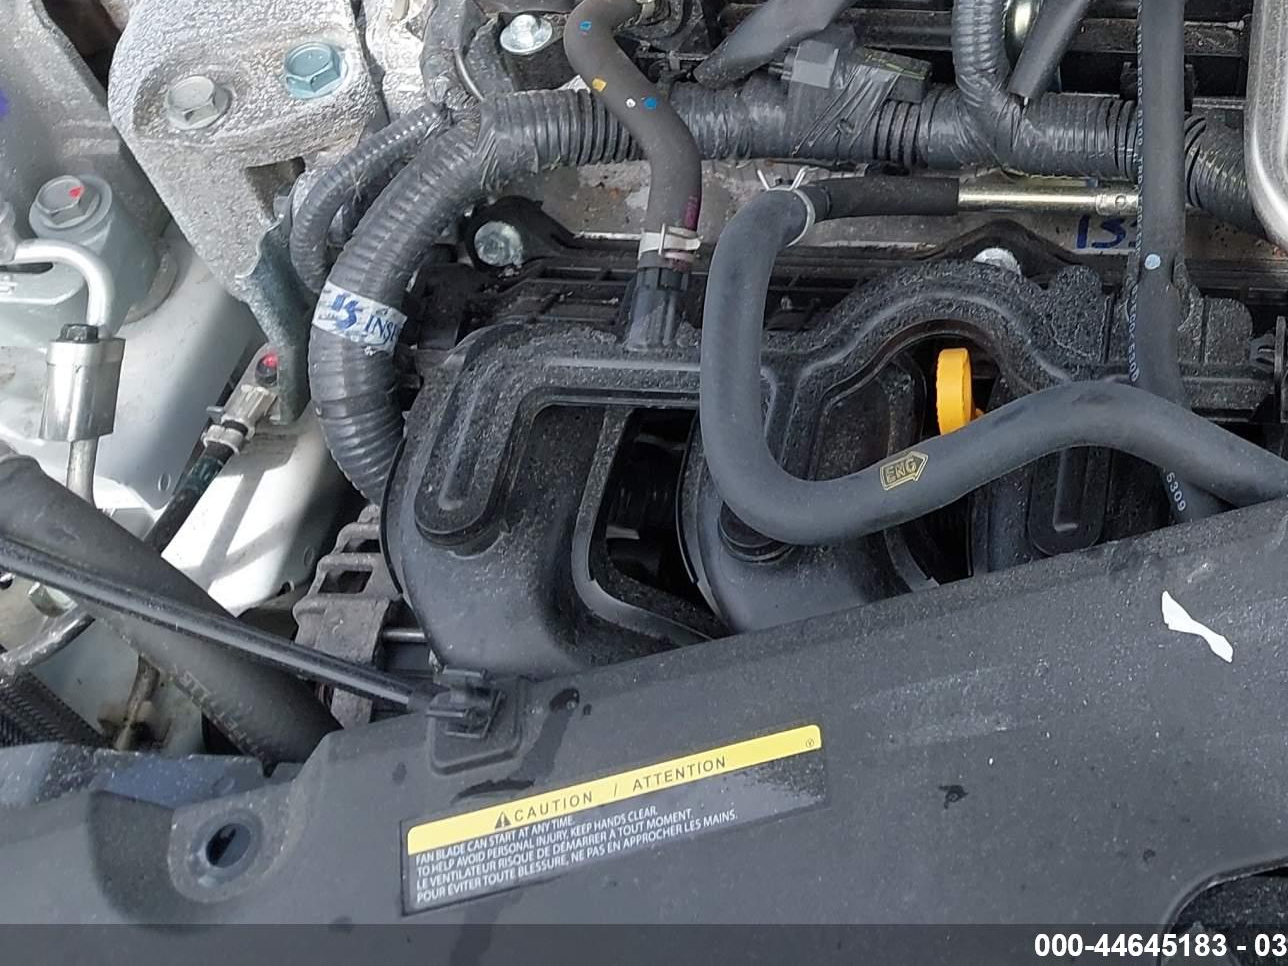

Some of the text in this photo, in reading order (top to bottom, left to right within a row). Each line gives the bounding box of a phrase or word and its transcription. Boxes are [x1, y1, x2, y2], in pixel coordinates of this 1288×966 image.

[885, 457, 917, 483] ENG
[514, 790, 593, 823] CAUTION
[632, 756, 727, 791] ATTENTION
[416, 814, 576, 865] FAN BLADE CAN START AT ANY TIME.
[416, 877, 428, 891] LE
[429, 859, 497, 887] VENTILATEUR
[498, 850, 535, 872] RISQUE
[537, 846, 550, 860] DE
[552, 832, 607, 857] DÉMARRER
[618, 819, 645, 836] TOUT
[646, 807, 694, 830] MOMENT.
[417, 805, 658, 877] TO HELP AVOID PERSONAL INJURY, KEEP HANDS CLEAR.
[417, 809, 738, 905] POUR ÉVITER TOUTE BLESSURE, NE PAS EN APPROCHER LES MAINS.
